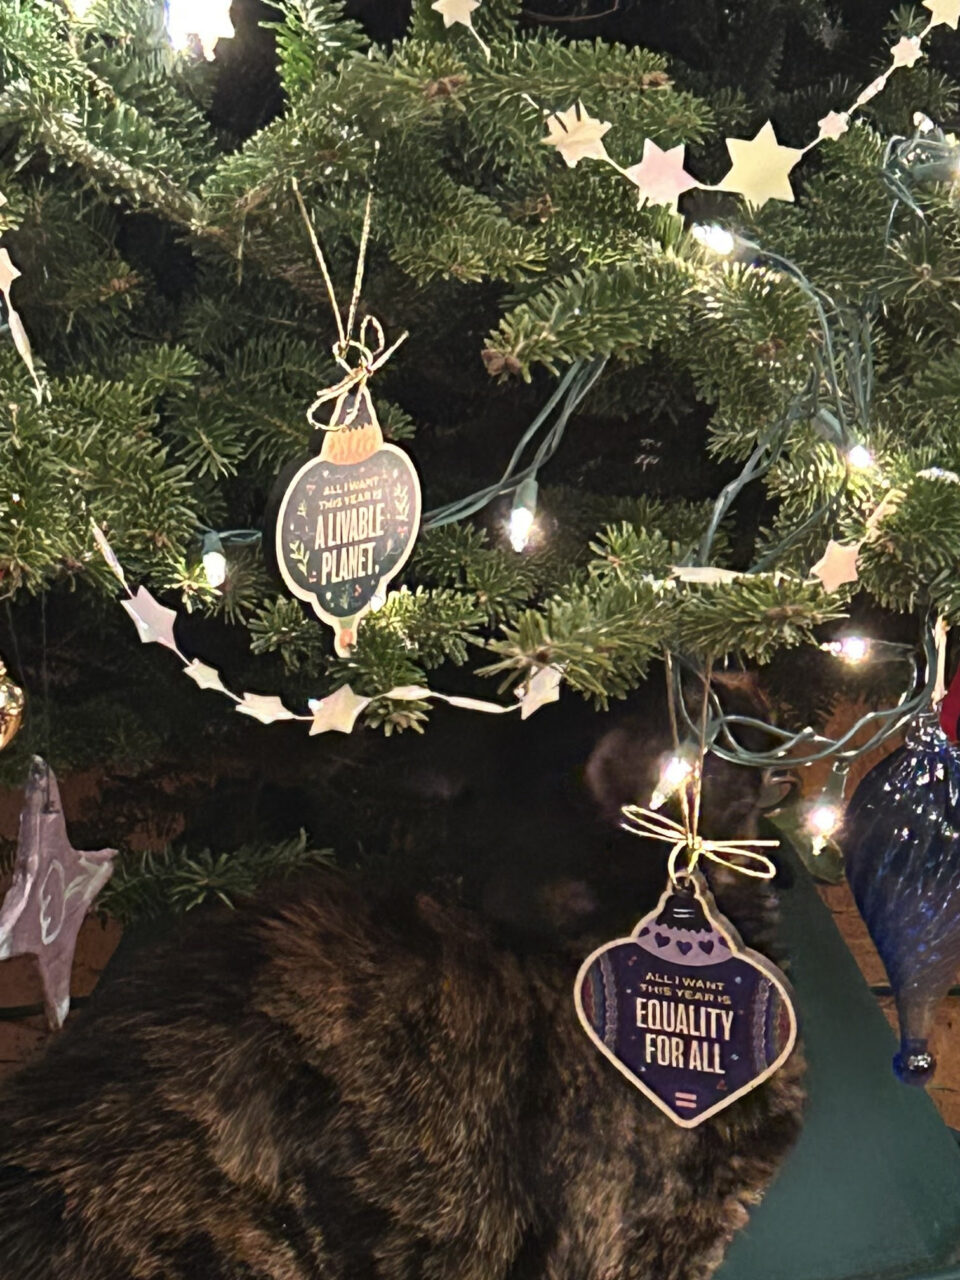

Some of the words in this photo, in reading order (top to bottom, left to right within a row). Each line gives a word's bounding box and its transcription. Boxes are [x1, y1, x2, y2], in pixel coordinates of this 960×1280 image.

[323, 484, 342, 495] ALL
[314, 514, 325, 550] A
[327, 502, 385, 547] LIVABLE
[640, 983, 672, 996] THIS
[676, 988, 714, 1001] YEAR
[717, 995, 732, 1005] IS
[645, 972, 673, 984] ALL
[675, 976, 679, 985] I
[682, 977, 725, 991] WANT
[635, 997, 734, 1041] EQUALITY
[645, 1033, 684, 1068] FOR
[689, 1041, 726, 1074] ALL
